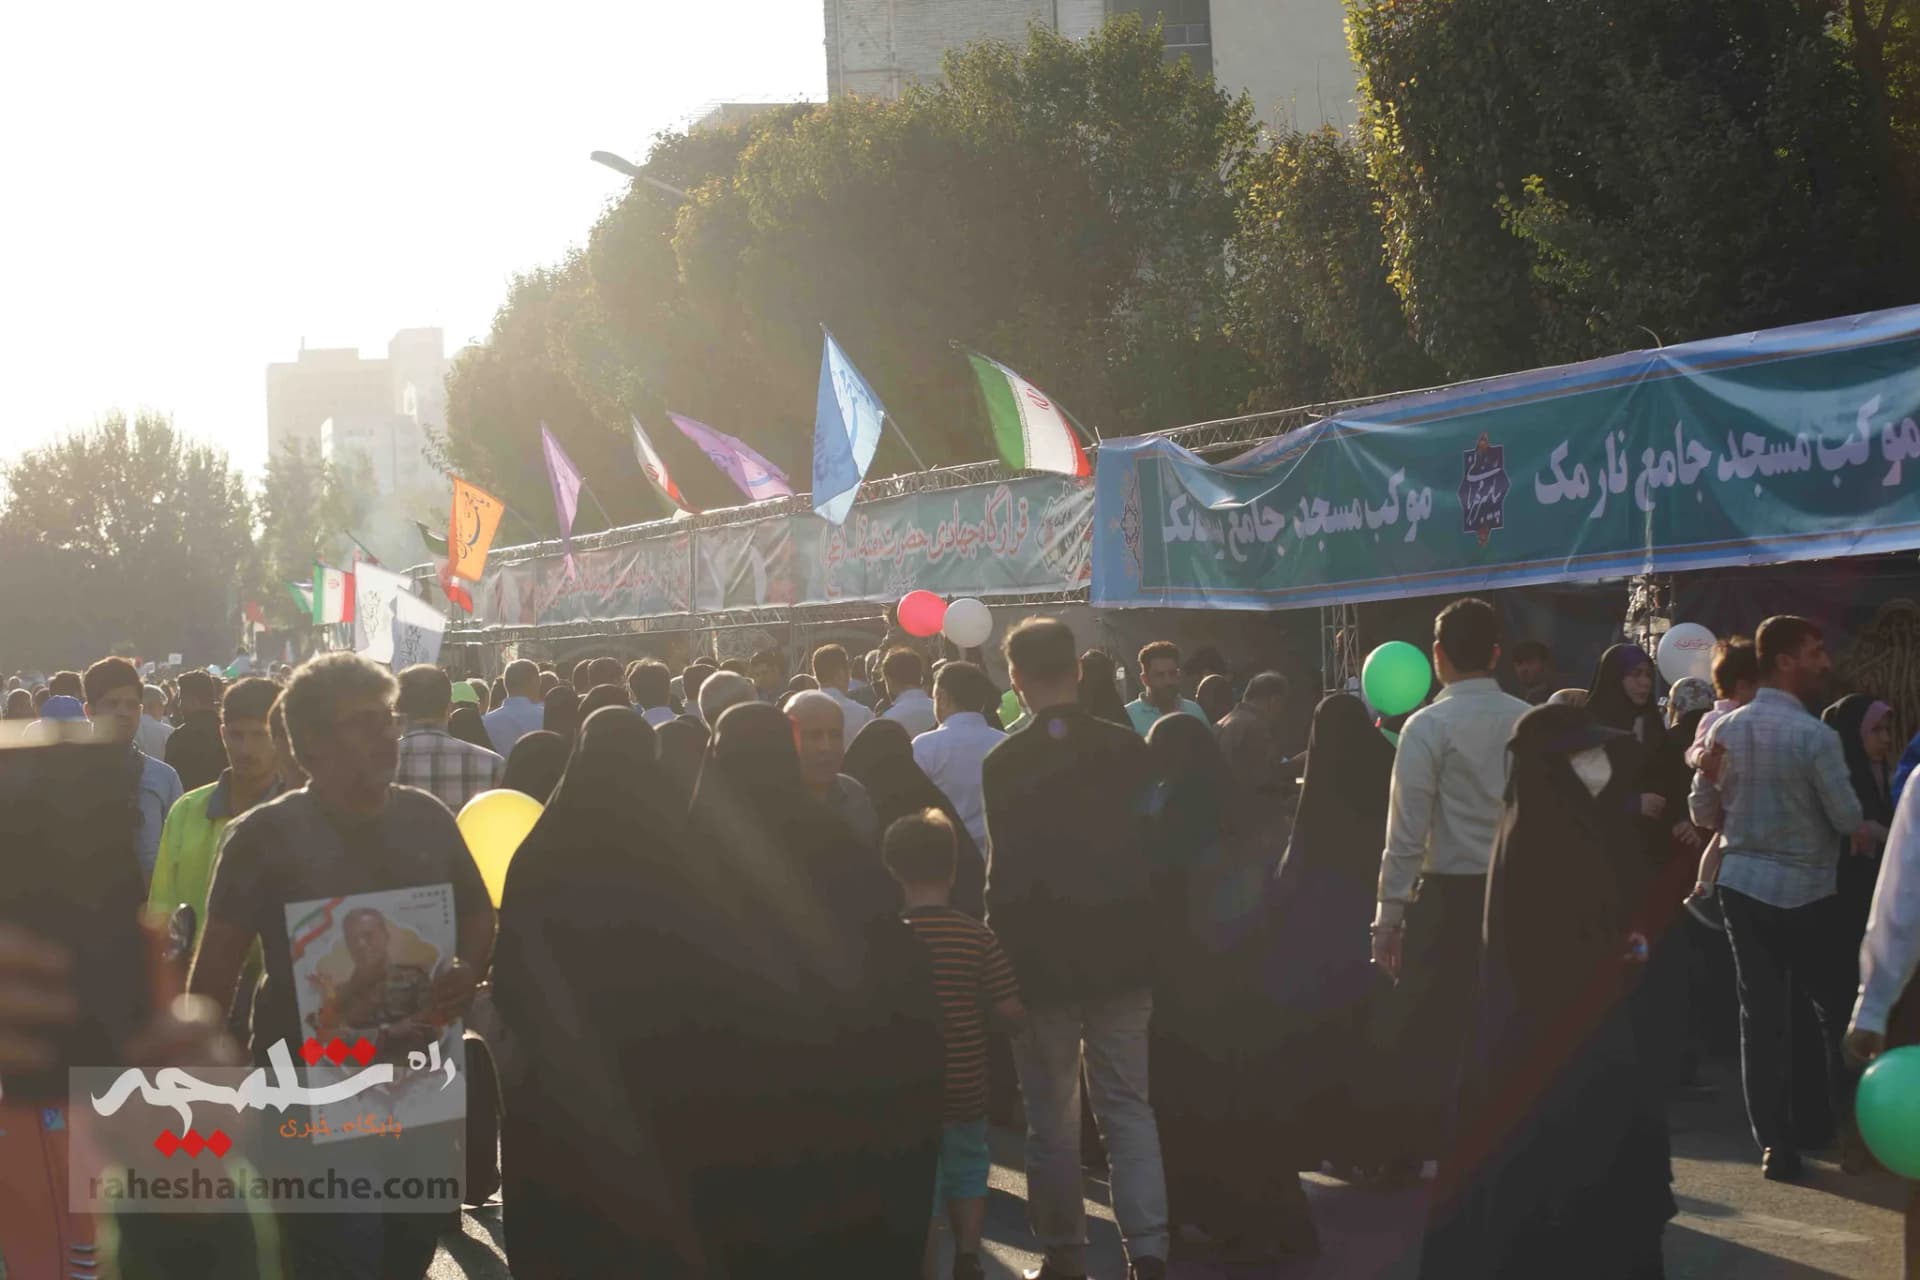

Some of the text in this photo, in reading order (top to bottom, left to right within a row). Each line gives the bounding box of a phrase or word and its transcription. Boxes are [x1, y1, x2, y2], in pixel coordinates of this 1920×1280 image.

[1534, 429, 1628, 518] نارمک
[1635, 419, 1712, 511] جامع
[1717, 428, 1811, 497] مسجد
[1228, 500, 1285, 562] جامع
[1295, 495, 1362, 552] مسجد
[1363, 466, 1432, 543] موکب
